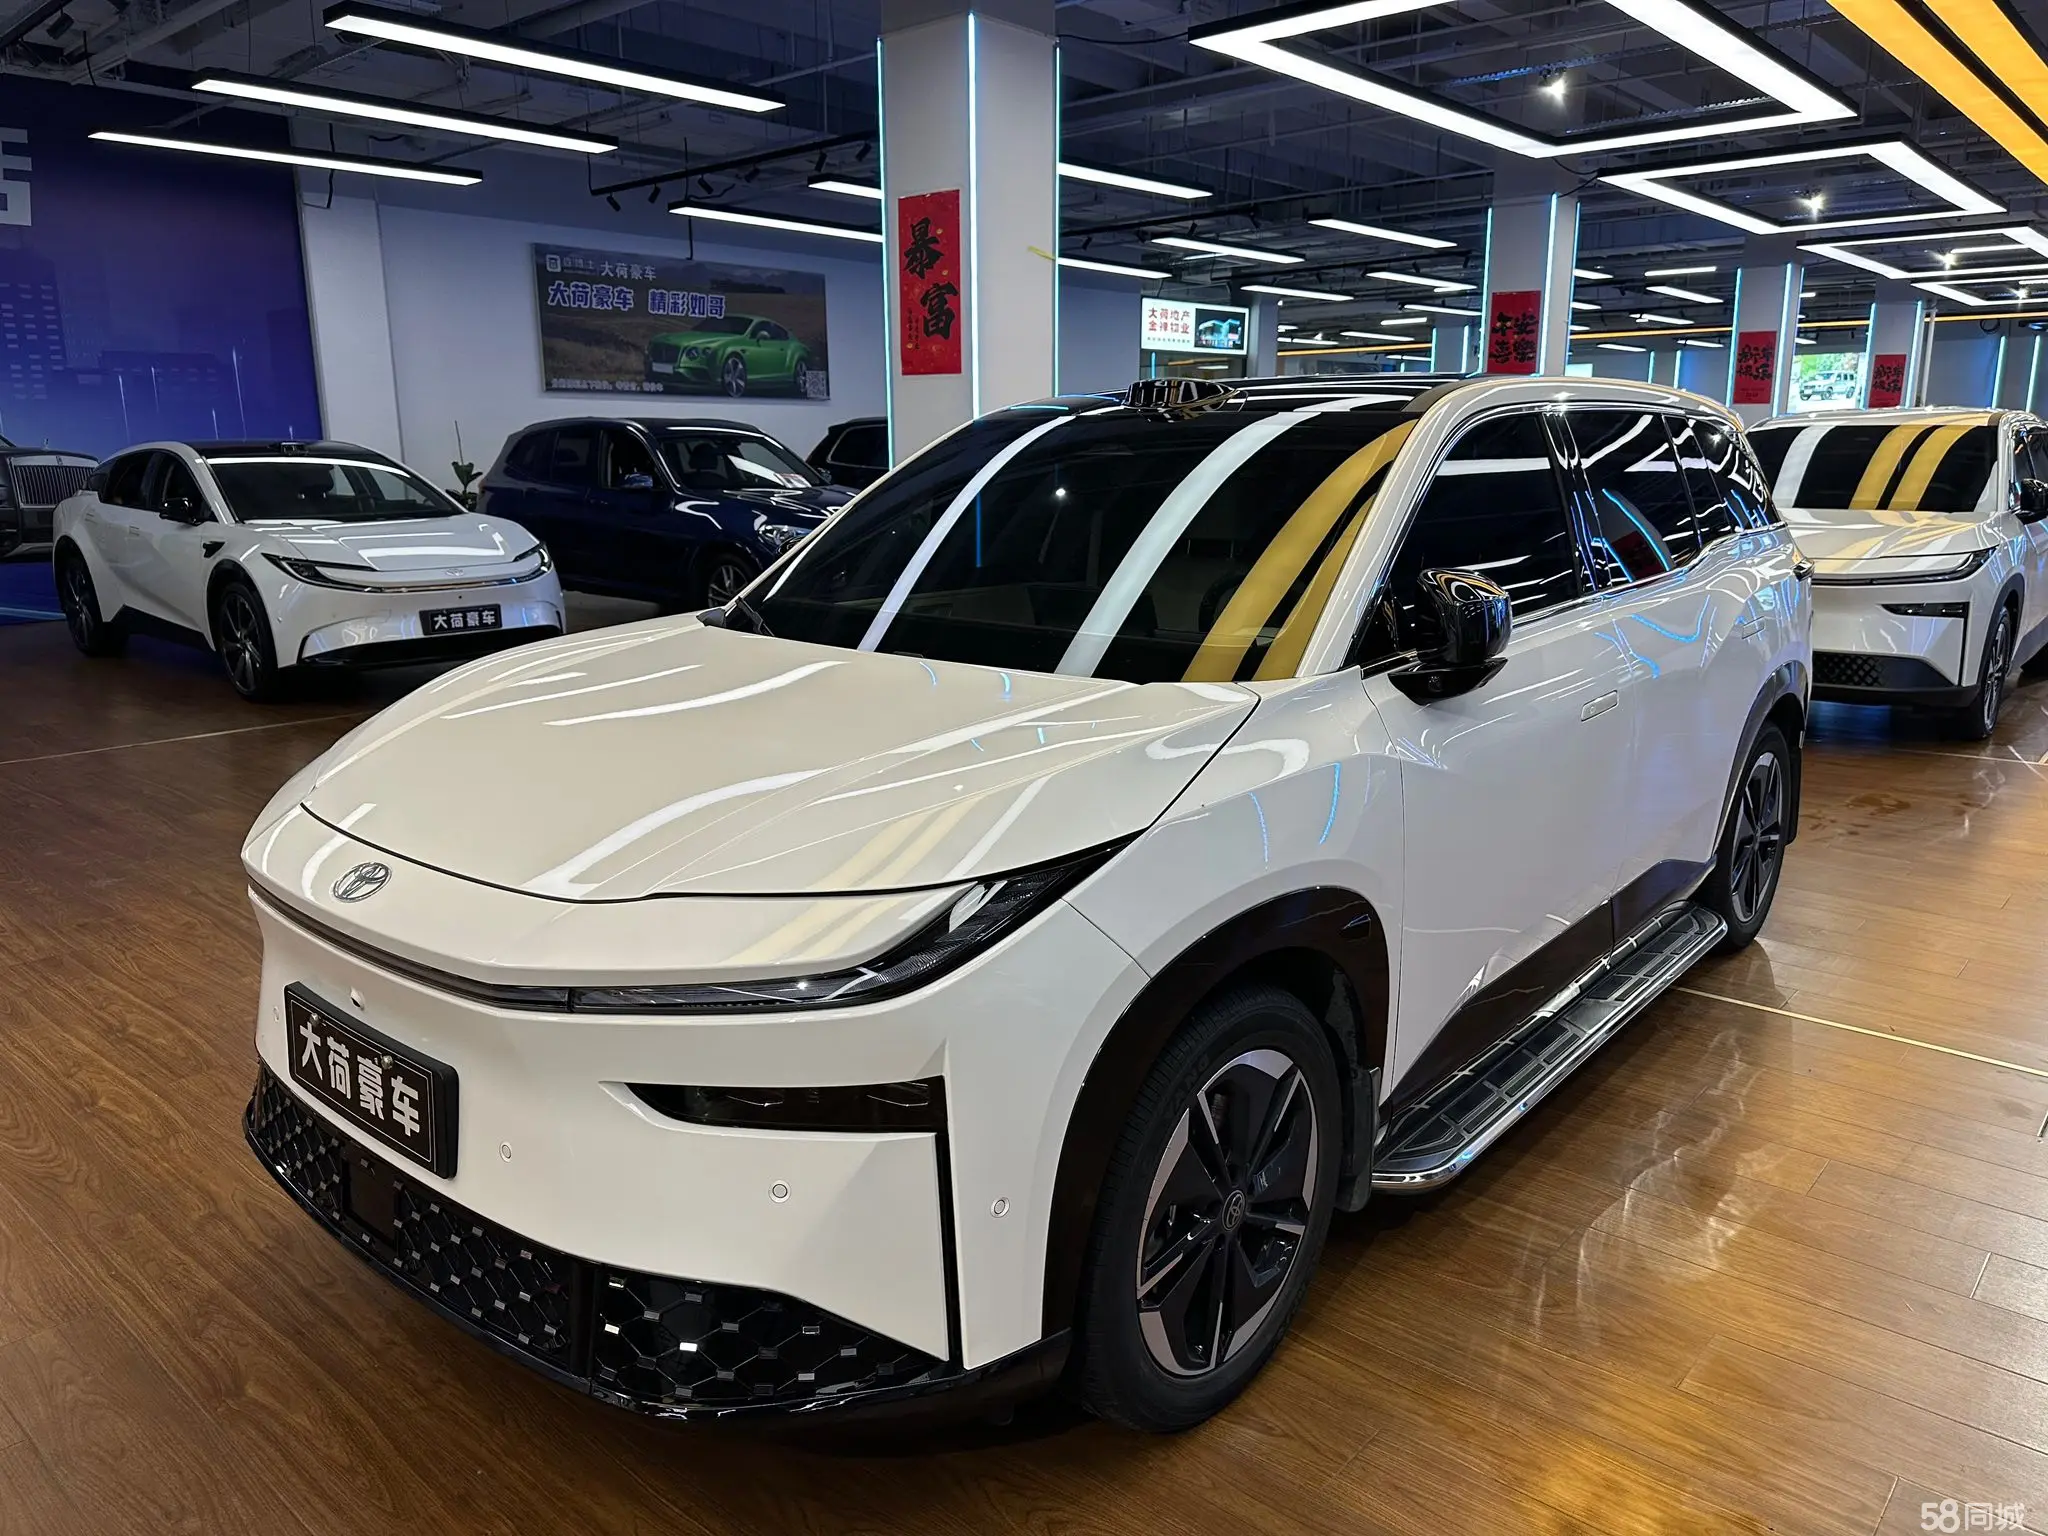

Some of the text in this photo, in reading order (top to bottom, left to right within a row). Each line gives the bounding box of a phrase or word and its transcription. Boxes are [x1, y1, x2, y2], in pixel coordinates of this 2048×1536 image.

[601, 262, 657, 281] 大荷豪车
[904, 216, 960, 340] 暴富
[548, 281, 726, 318] 大荷豪车 精彩如哥
[434, 610, 496, 630] 大荷豪车
[300, 1021, 420, 1136] 大荷豪车
